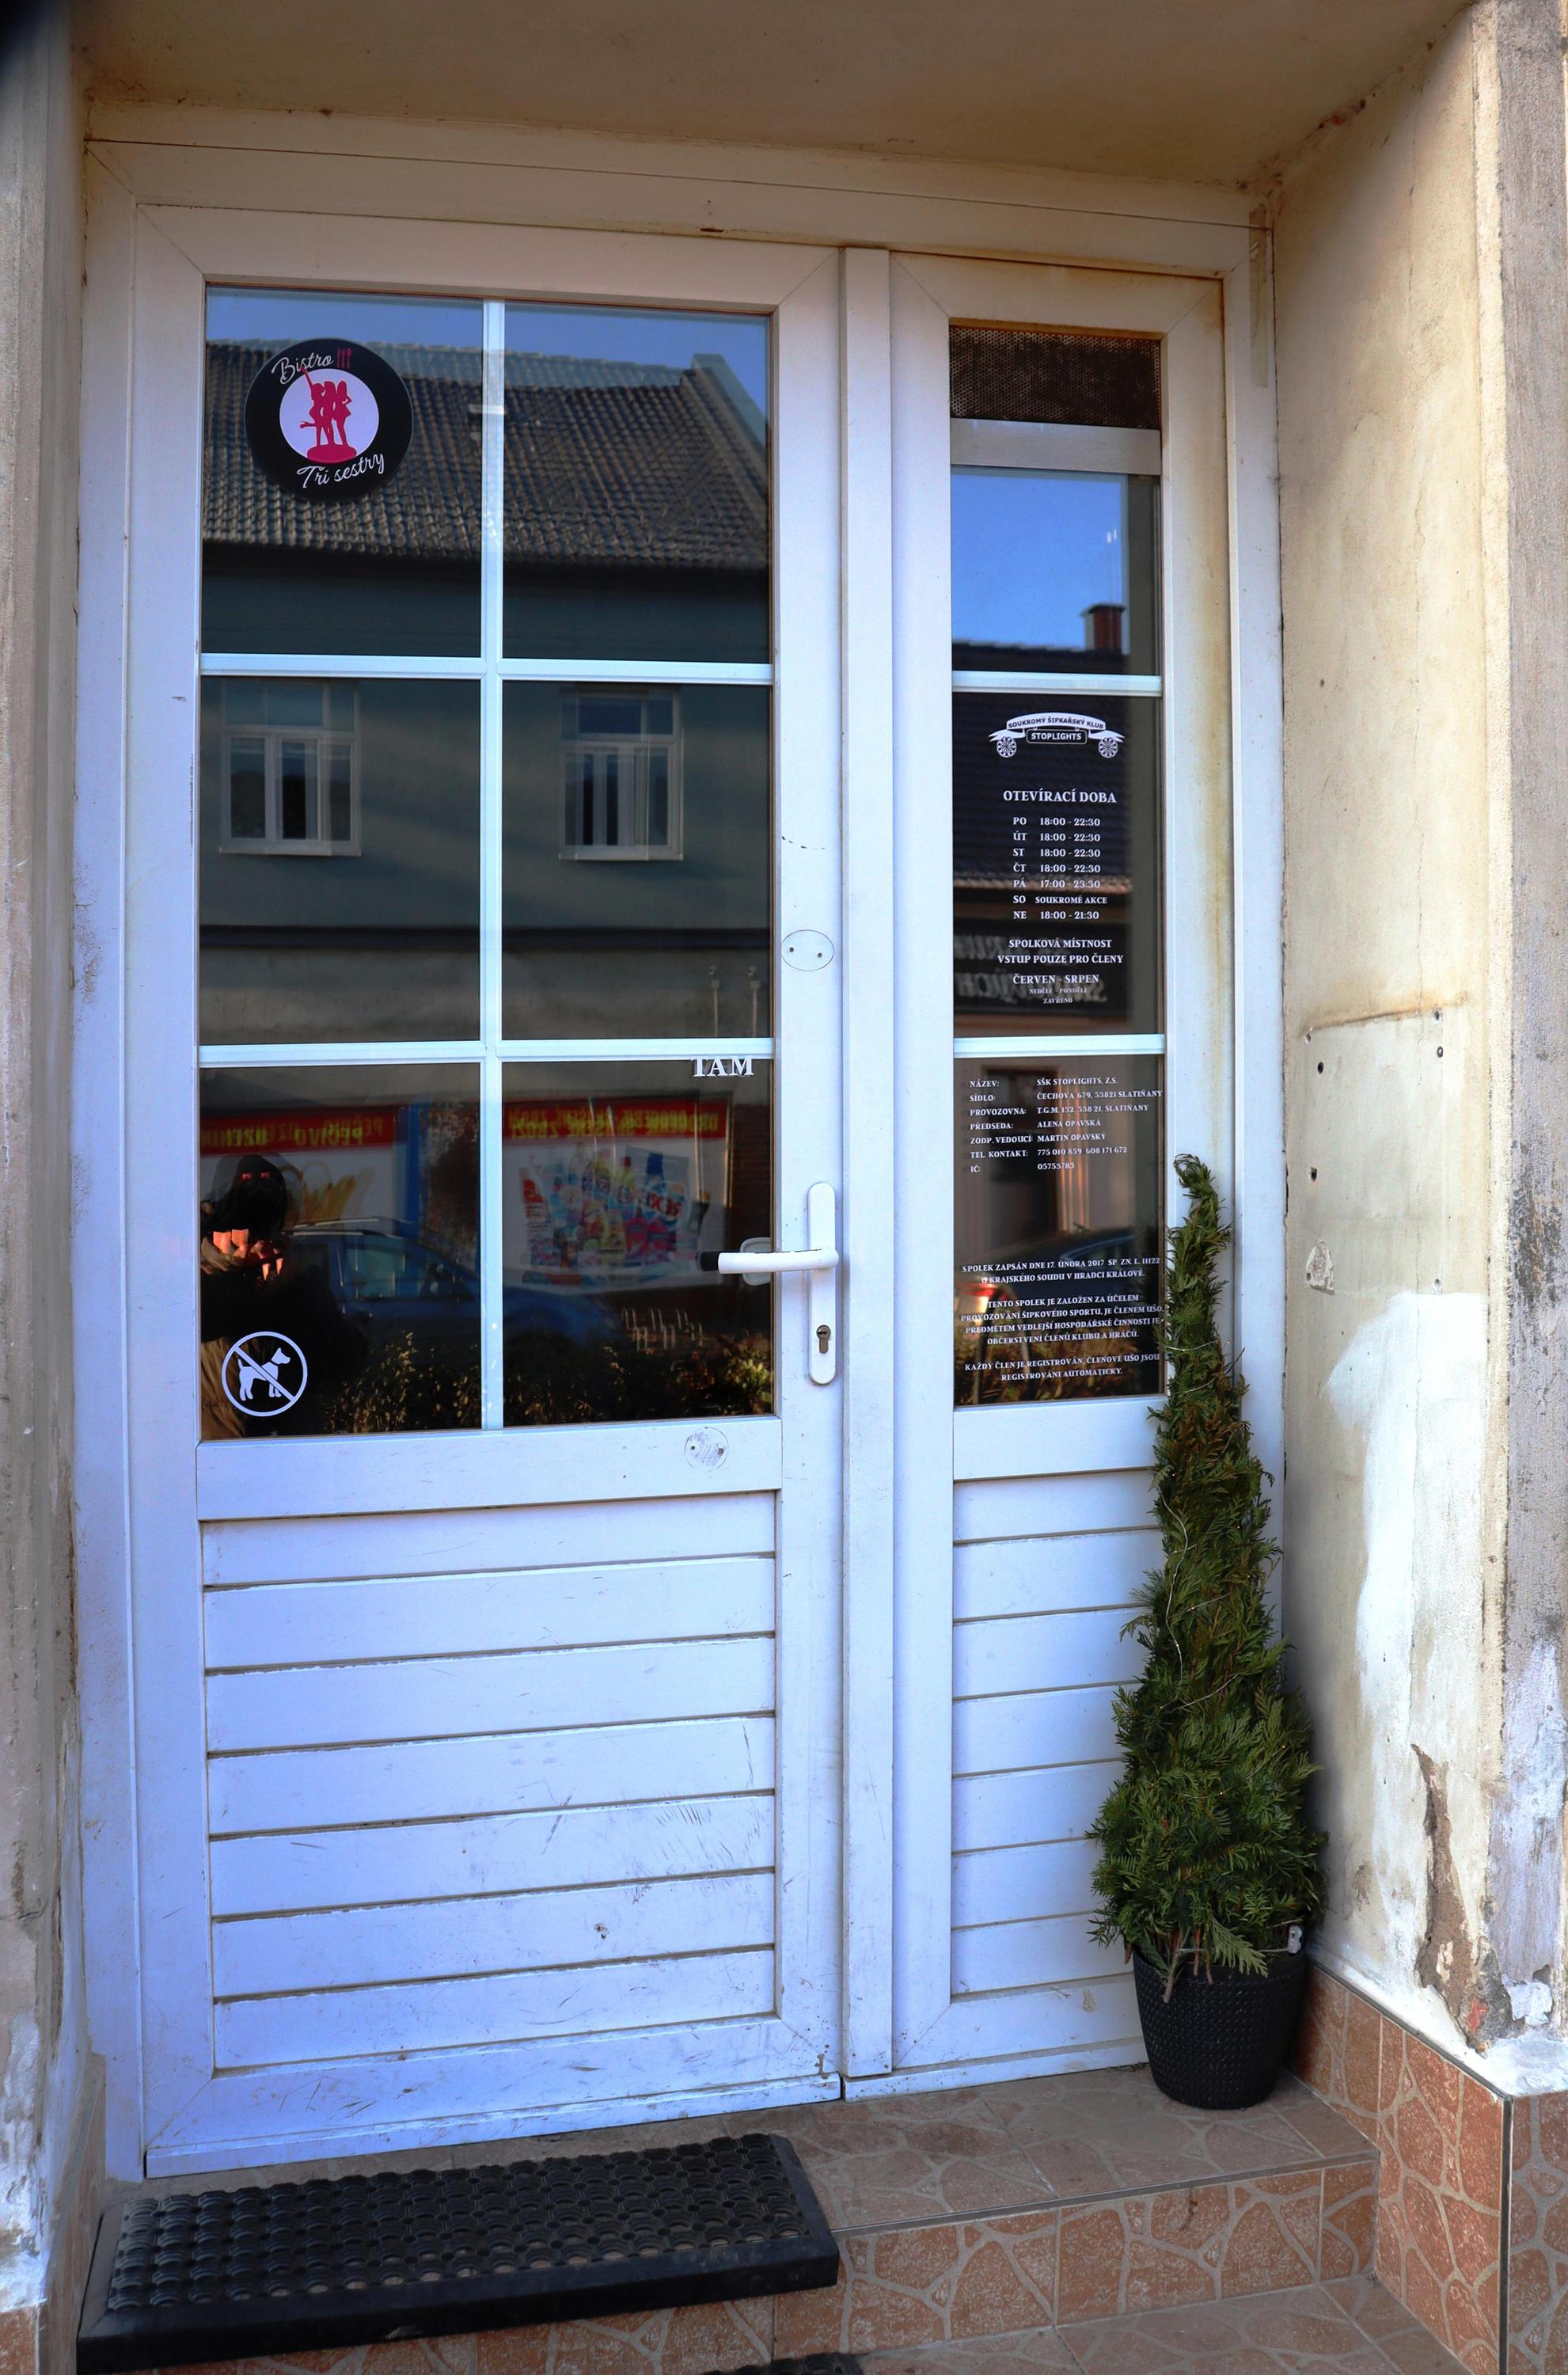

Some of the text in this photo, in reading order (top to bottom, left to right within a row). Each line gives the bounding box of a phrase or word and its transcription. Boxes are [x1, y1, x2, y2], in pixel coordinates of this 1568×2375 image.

[271, 352, 334, 385] Bistro
[296, 453, 385, 488] Tři sestry
[1008, 717, 1046, 728] SOUKROMÝ
[1047, 715, 1086, 725] ŠIPKAŘSKÝ
[1031, 732, 1082, 741] STOPLIGHTS
[1003, 788, 1117, 804] OTEVÍRACÍ DOBA
[1040, 817, 1066, 826] 18:00
[1073, 818, 1101, 826] 22:30
[1013, 830, 1027, 841] ÚT
[1040, 833, 1066, 842] 18:00
[1073, 833, 1101, 842] 22:30
[1013, 848, 1025, 857] ST
[1040, 849, 1066, 857] 18:00
[1073, 849, 1101, 857] 22:30
[1013, 862, 1027, 872] ČT
[1040, 864, 1066, 872] 18:00
[1073, 864, 1101, 873] 22:30
[1013, 877, 1027, 888] PÁ
[1040, 880, 1065, 888] 17:00
[1073, 880, 1101, 888] 23:30
[1013, 895, 1027, 904] SO
[1035, 895, 1084, 904] SOUKROMÉ
[1013, 910, 1027, 919] NE
[1040, 910, 1067, 919] 18:00
[1074, 910, 1099, 919] 21:30
[1008, 937, 1061, 948] SPOLKOVÁ
[1062, 937, 1113, 948] MÍSTNOST
[997, 952, 1124, 963] VSTUP POUZE PRO ČLENY
[1012, 973, 1056, 984] ČERVEN
[1065, 974, 1100, 983] SRPEN
[690, 1055, 754, 1077] TAM
[970, 1078, 1000, 1088] NÁZEV:
[970, 1108, 1027, 1116] PROVOZOVNA:
[1105, 1103, 1148, 1112] SLATIŇANY
[970, 1122, 1014, 1130] PŘEDSEDA:
[1065, 1118, 1101, 1127] OPAVSKÁ
[1037, 1134, 1069, 1142] MARTIN
[1071, 1131, 1107, 1141] OPAVSKÝ
[962, 1264, 993, 1273] SPOLEK
[995, 1261, 1027, 1271] ZAPSÁN
[989, 1273, 1035, 1284] KRAJSKÉHO
[1037, 1273, 1065, 1282] SOUDU
[1073, 1271, 1105, 1280] HRADCI
[1047, 1298, 1055, 1306] JE
[1057, 1295, 1093, 1305] ZALOŽEN
[1107, 1294, 1139, 1302] ÚČELEM
[1022, 1309, 1068, 1318] ŠIPKOVÉHO
[1104, 1307, 1113, 1316] JE
[1114, 1305, 1145, 1314] ČLENEM
[1017, 1320, 1054, 1331] VEDLEJŠÍ
[1054, 1318, 1113, 1329] HOSPODÁŘSKÉ
[1114, 1317, 1150, 1326] ČINNOSTI
[995, 1360, 1016, 1370] ČLEN
[1016, 1361, 1026, 1370] JE
[1086, 1355, 1122, 1364] ČLENOVÉ
[1124, 1353, 1140, 1362] UŠO
[1141, 1353, 1160, 1362] JSOU
[1001, 1370, 1061, 1381] REGISTROVÁNI
